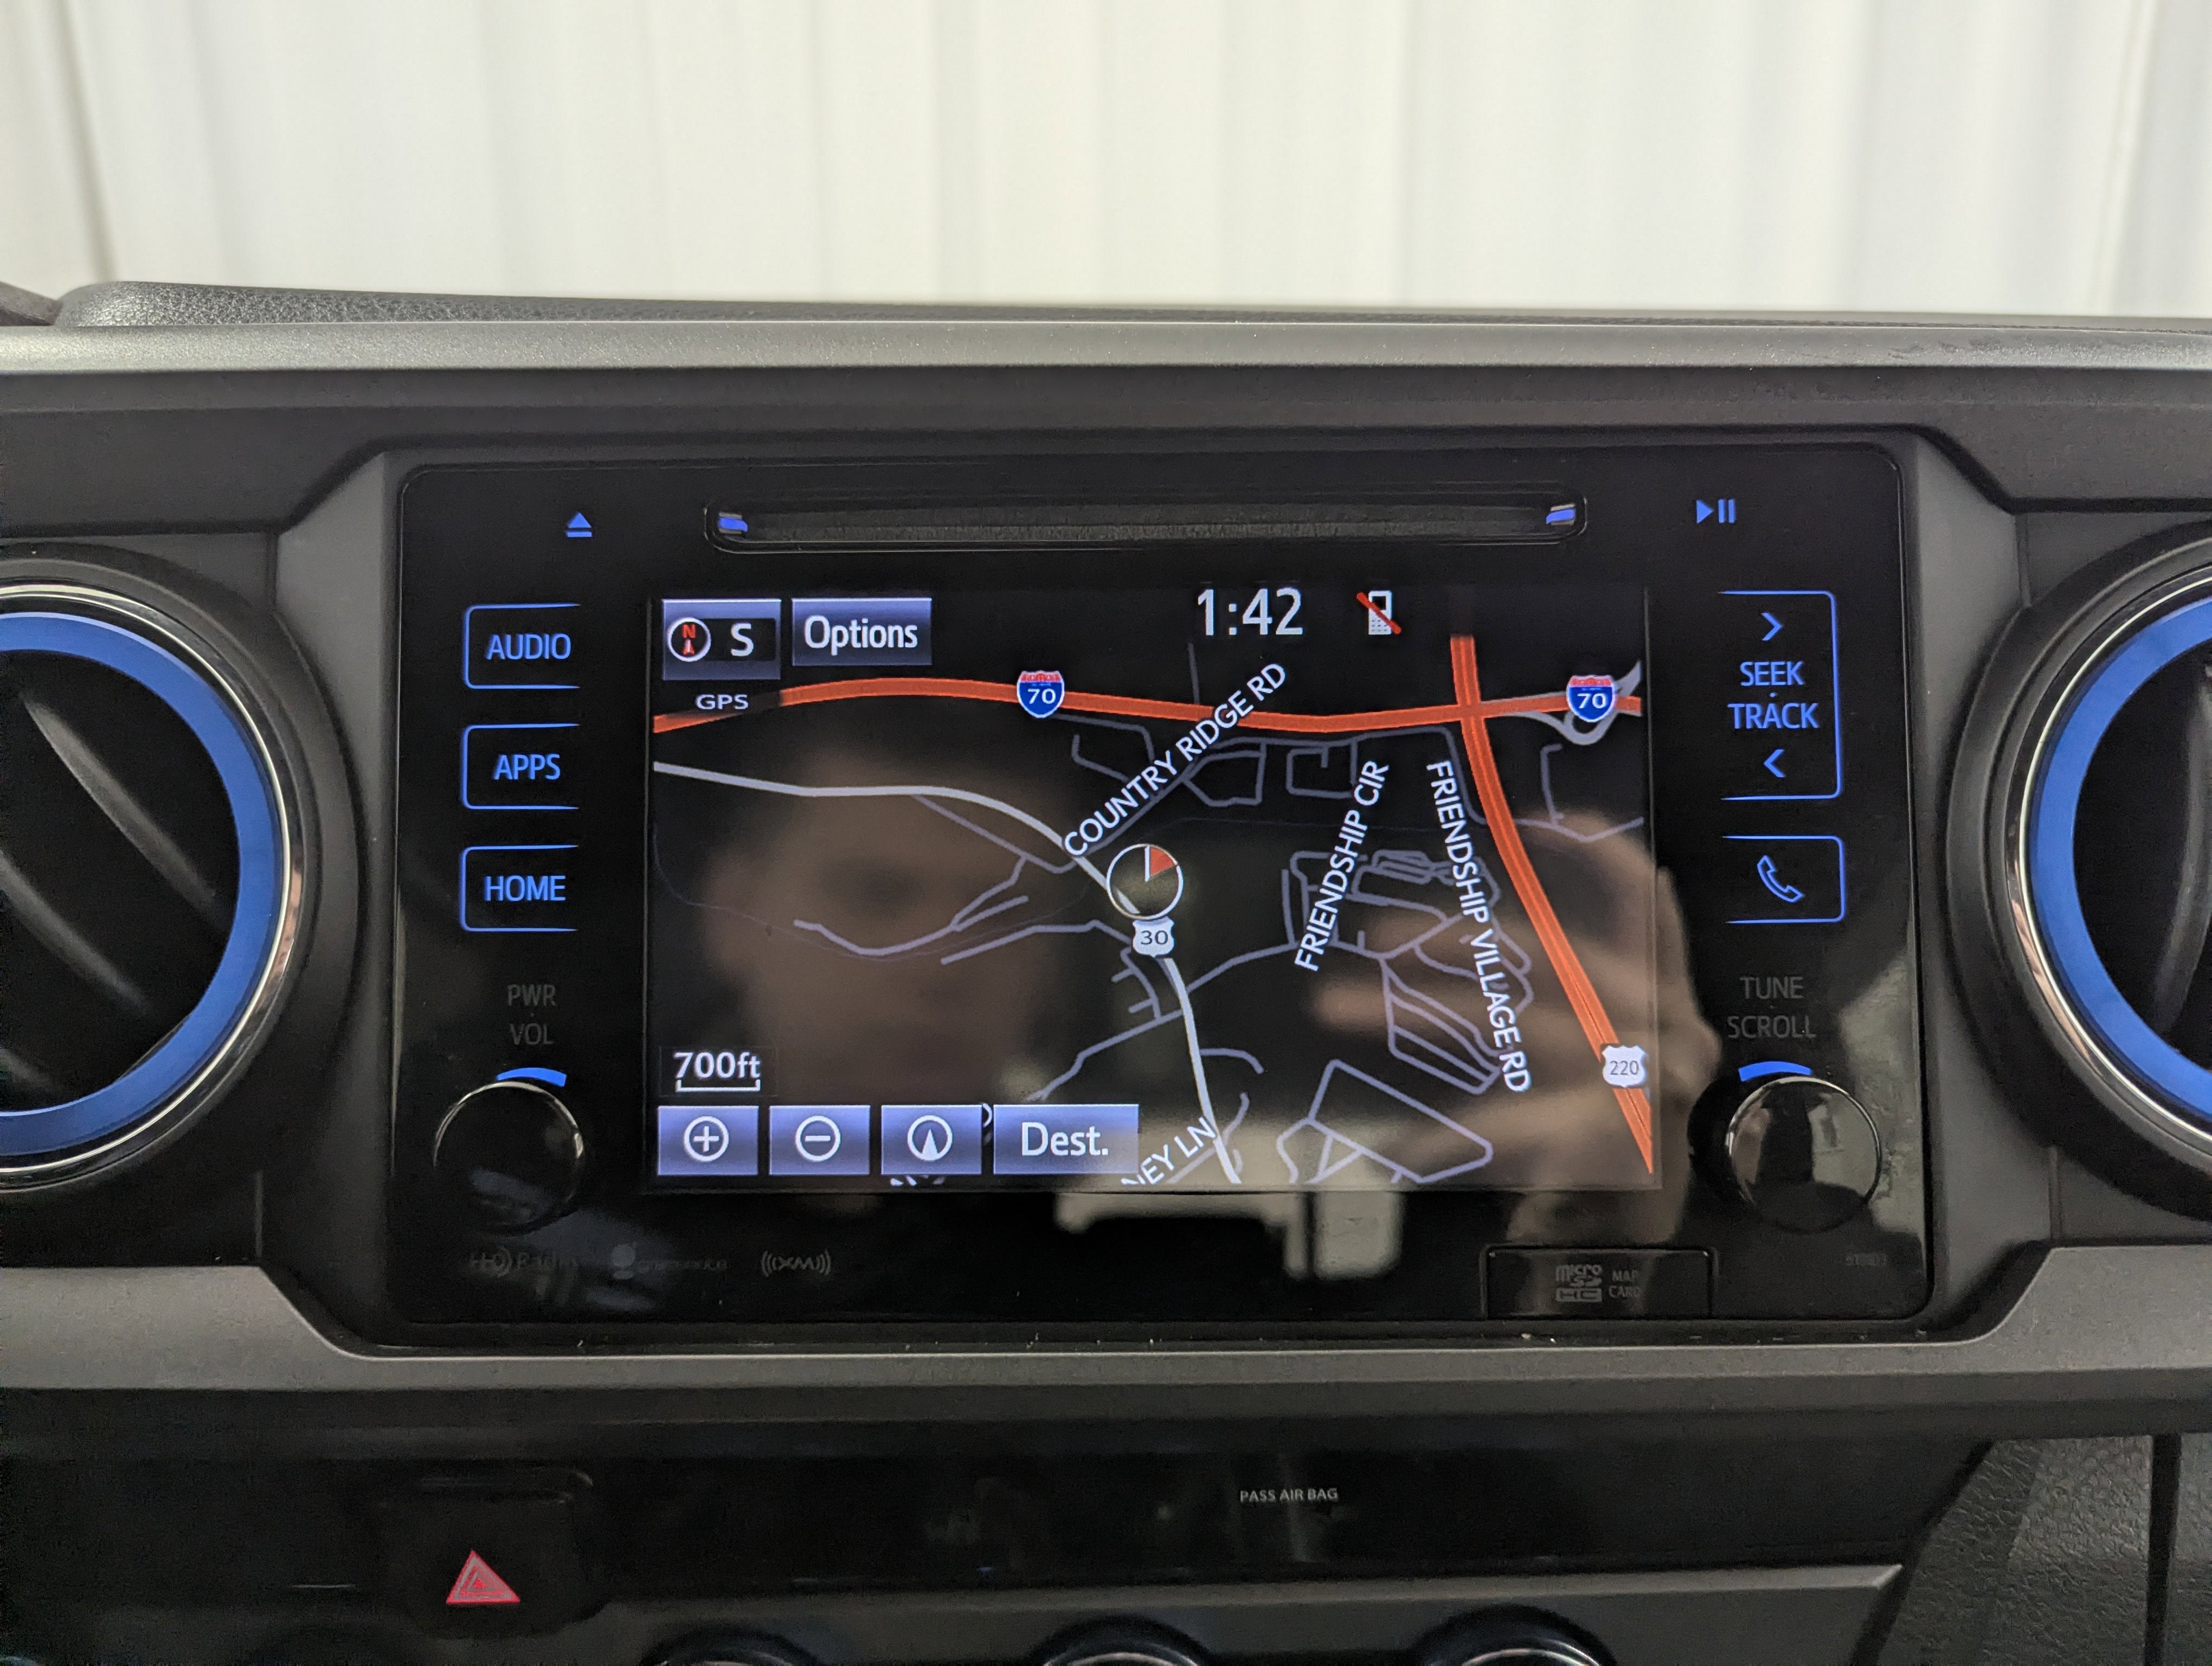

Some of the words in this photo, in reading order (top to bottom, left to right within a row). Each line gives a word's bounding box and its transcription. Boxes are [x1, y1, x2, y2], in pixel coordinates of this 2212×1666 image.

[1197, 587, 1303, 636] 1:42
[681, 624, 697, 639] N
[730, 623, 754, 657] S
[804, 615, 918, 656] Options
[485, 633, 571, 660] AUDIO
[1740, 660, 1805, 687] SEEK
[696, 694, 749, 710] GPS
[1027, 688, 1056, 704] 70
[1577, 693, 1607, 709] 70
[1728, 702, 1819, 729] TRACK
[493, 754, 561, 780] APPS
[1063, 751, 1178, 856] COUNTRY
[1175, 691, 1254, 762] RIDGE
[1247, 663, 1287, 701] RD
[1294, 810, 1368, 971] FRIENDSHIP
[1354, 760, 1390, 806] CIR
[484, 875, 567, 901] HOME
[1140, 930, 1168, 945] 30
[1426, 760, 1491, 923] FRIENDSHIP
[1470, 928, 1521, 1048] VILLAGE
[1499, 1050, 1532, 1093] RD
[507, 984, 556, 1007] PWR
[1740, 977, 1804, 999] TUNE
[510, 1023, 555, 1046] VOL
[1727, 1016, 1817, 1040] SCROLL
[673, 1051, 761, 1080] 700ft
[1609, 1060, 1639, 1075] 220
[1021, 1122, 1109, 1156] Dest.
[1174, 1116, 1216, 1158] LN
[1611, 1269, 1639, 1282] MAP
[1608, 1284, 1642, 1299] CARD
[1240, 1489, 1276, 1503] PASS
[1279, 1488, 1304, 1502] AIR
[1307, 1487, 1339, 1502] BAG
